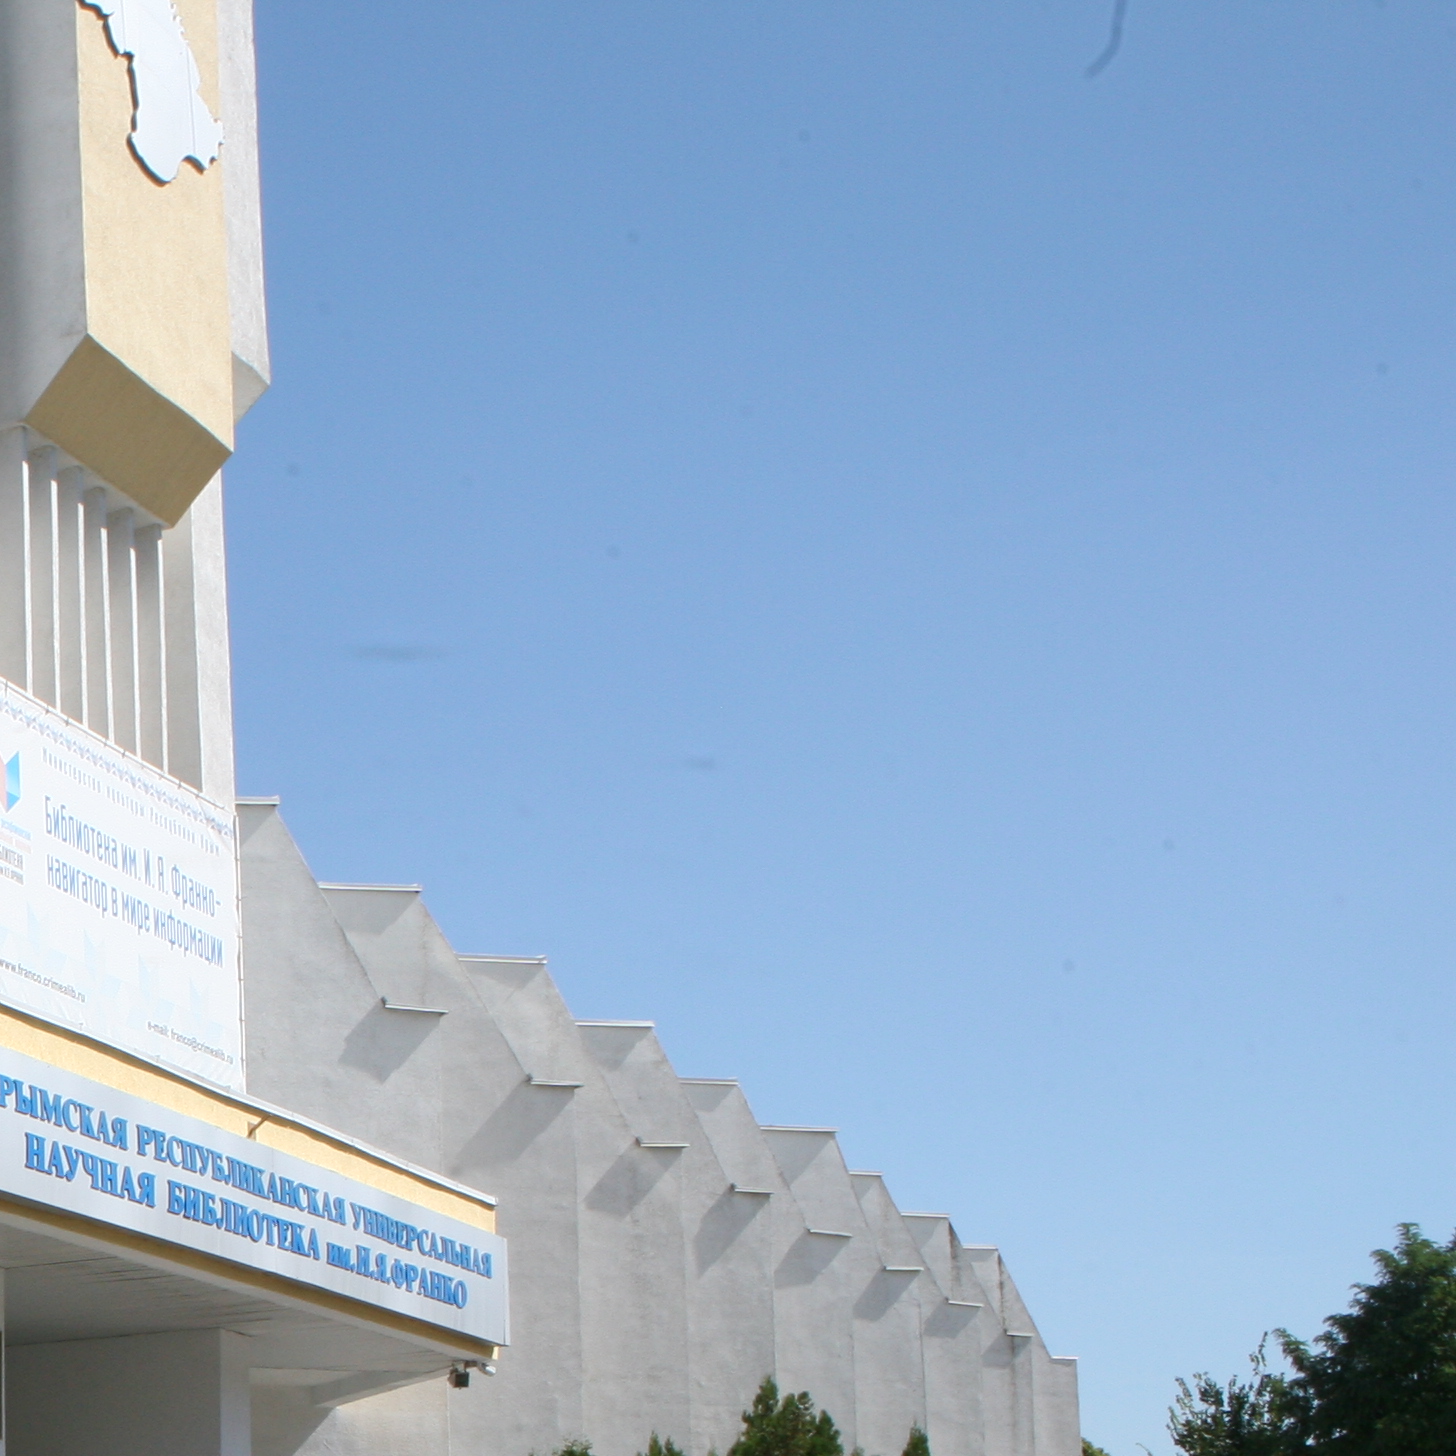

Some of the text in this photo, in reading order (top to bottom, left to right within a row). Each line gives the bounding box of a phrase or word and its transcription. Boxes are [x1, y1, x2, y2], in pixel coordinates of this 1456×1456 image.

[44, 794, 119, 870] Библиотека
[120, 842, 142, 882] им.
[142, 847, 156, 889] И.
[46, 853, 108, 919] навигатор
[110, 885, 119, 918] в
[120, 890, 151, 936] мире
[152, 906, 224, 969] информации
[24, 1131, 157, 1208] НАУЧНАЯ
[167, 1178, 321, 1261] БИБЛИОТЕКА
[135, 1123, 347, 1227] РЕСПУБЛИКАНСКАЯ
[349, 1201, 493, 1280] УНИВЕРСАЛЬНАЯ
